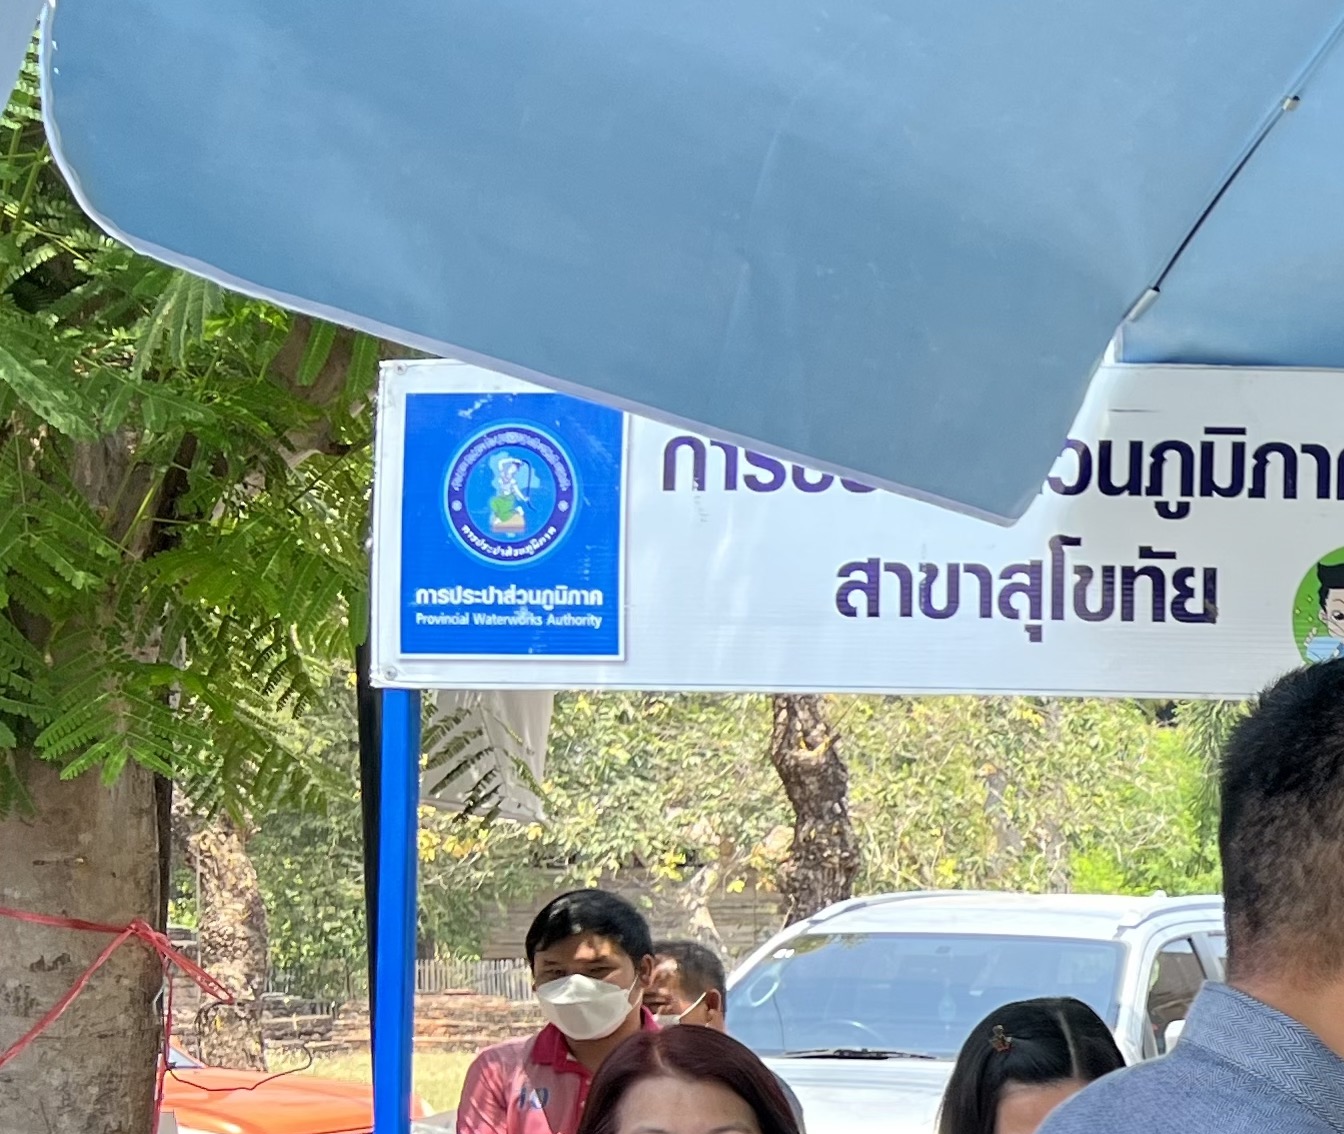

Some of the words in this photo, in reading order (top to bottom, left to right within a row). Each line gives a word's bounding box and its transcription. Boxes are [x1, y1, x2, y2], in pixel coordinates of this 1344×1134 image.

[415, 584, 603, 611] การประปาส่วนภูมิภาค
[834, 534, 1218, 642] สาขาสุโขทัย
[415, 612, 469, 626] Provincial
[473, 612, 542, 626] Waterworks
[547, 613, 602, 629] Authority
